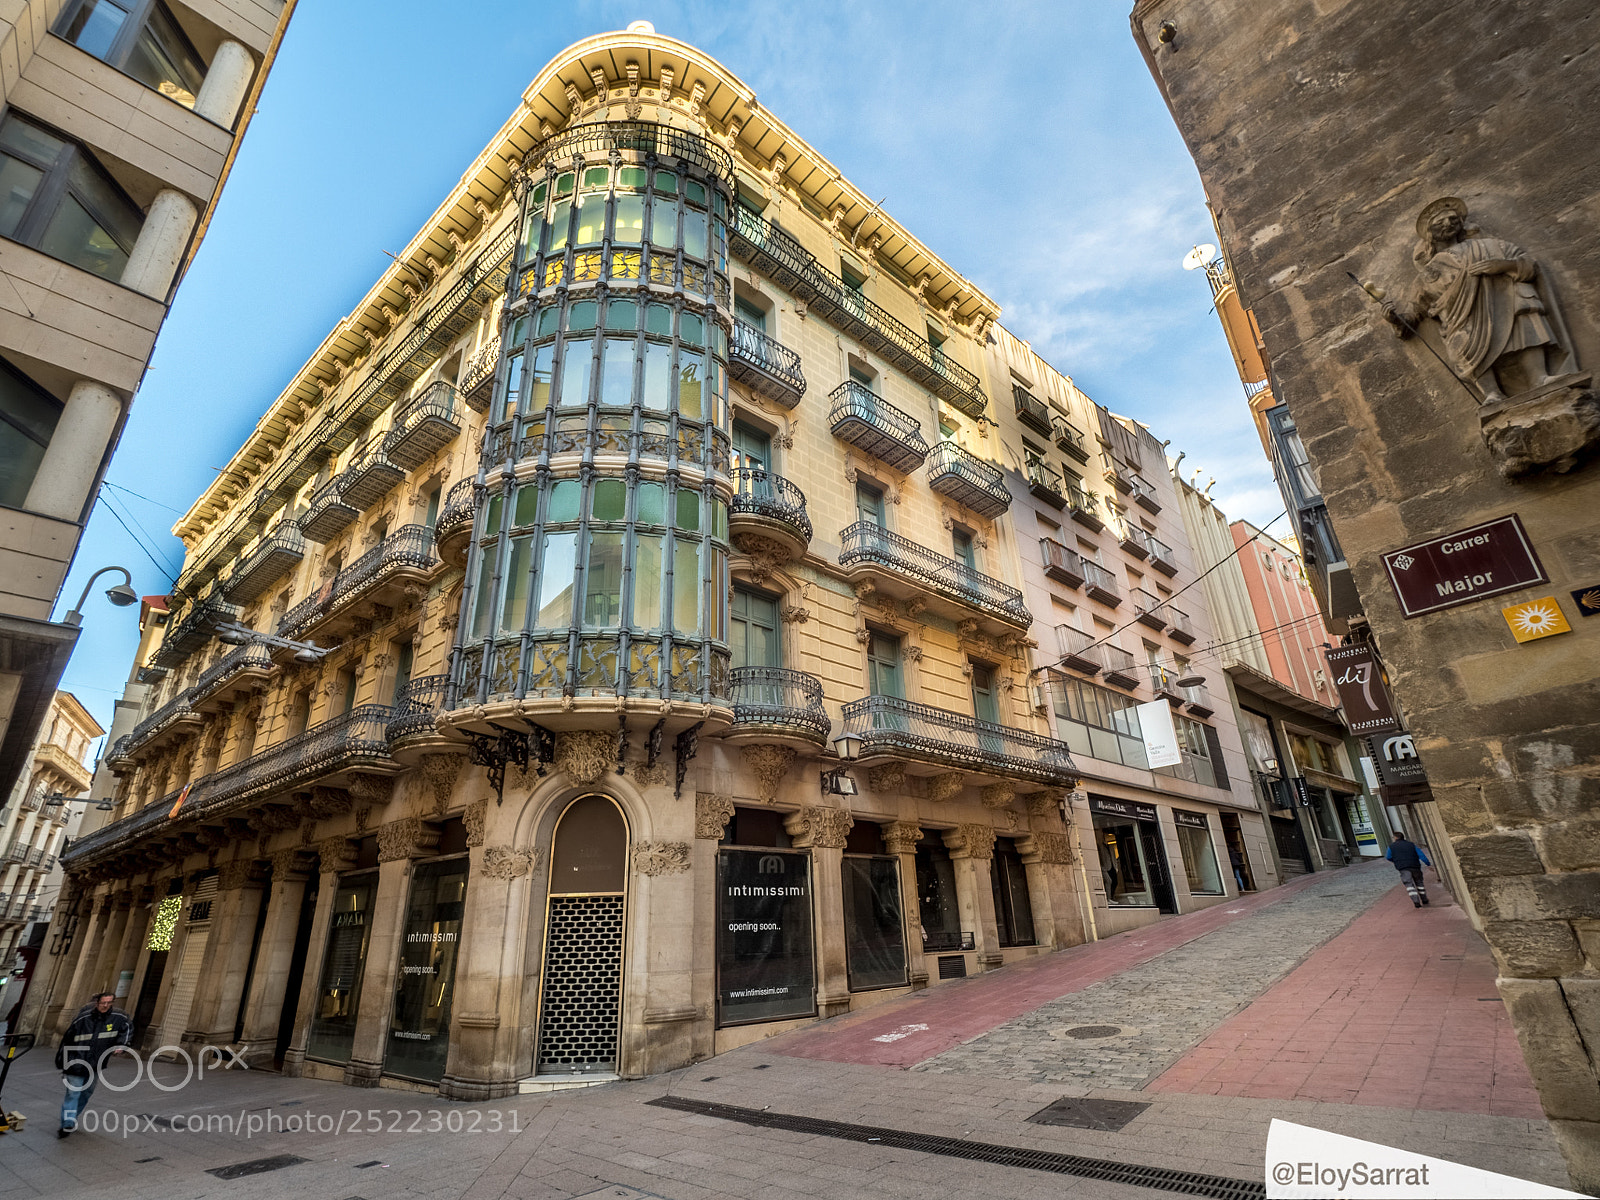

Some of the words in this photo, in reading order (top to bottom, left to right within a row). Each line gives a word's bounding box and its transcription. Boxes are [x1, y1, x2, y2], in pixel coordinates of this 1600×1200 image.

[1441, 533, 1490, 554] Carrer
[1435, 571, 1493, 597] Major
[728, 884, 804, 897] intimissimi
[728, 921, 758, 933] opening
[407, 932, 457, 943] intimissimi
[404, 965, 421, 976] opening
[730, 986, 789, 998] www.intimissimi.com
